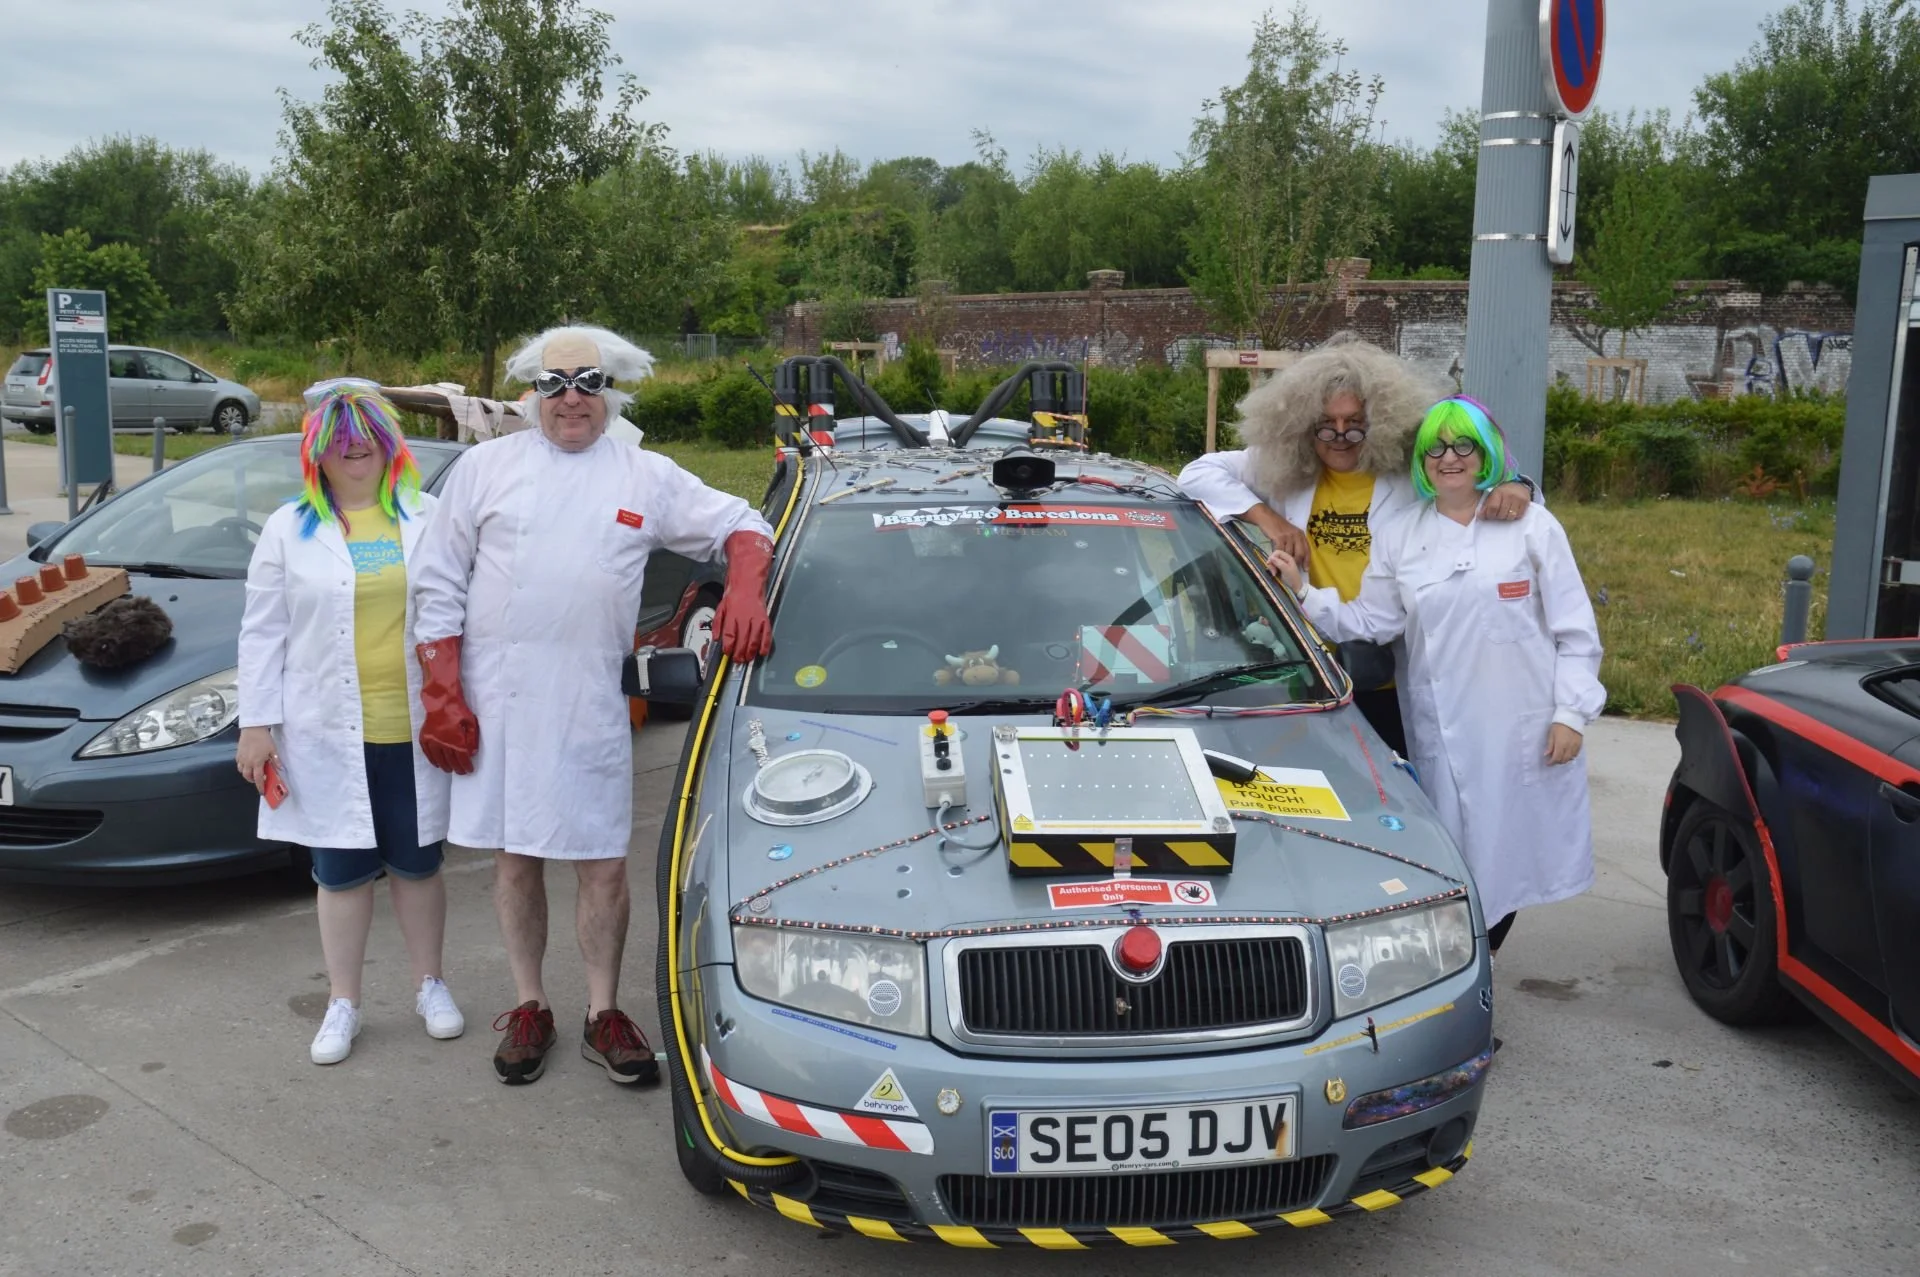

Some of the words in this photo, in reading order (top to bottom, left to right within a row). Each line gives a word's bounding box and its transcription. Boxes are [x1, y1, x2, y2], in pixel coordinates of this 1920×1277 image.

[58, 293, 72, 309] P
[882, 511, 962, 526] Barmy
[1004, 509, 1120, 521] Barcelona
[1232, 781, 1257, 791] DO
[1263, 785, 1298, 795] NOT
[1236, 790, 1305, 804] TOUCH!
[1230, 799, 1264, 809] Pure
[1268, 805, 1322, 815] Plasma
[1059, 883, 1112, 895] Authorised
[1114, 882, 1162, 892] Personnel
[1102, 893, 1124, 902] Only
[864, 1100, 909, 1113] behringer
[993, 1145, 1016, 1161] SCO
[1188, 1103, 1287, 1157] DJV
